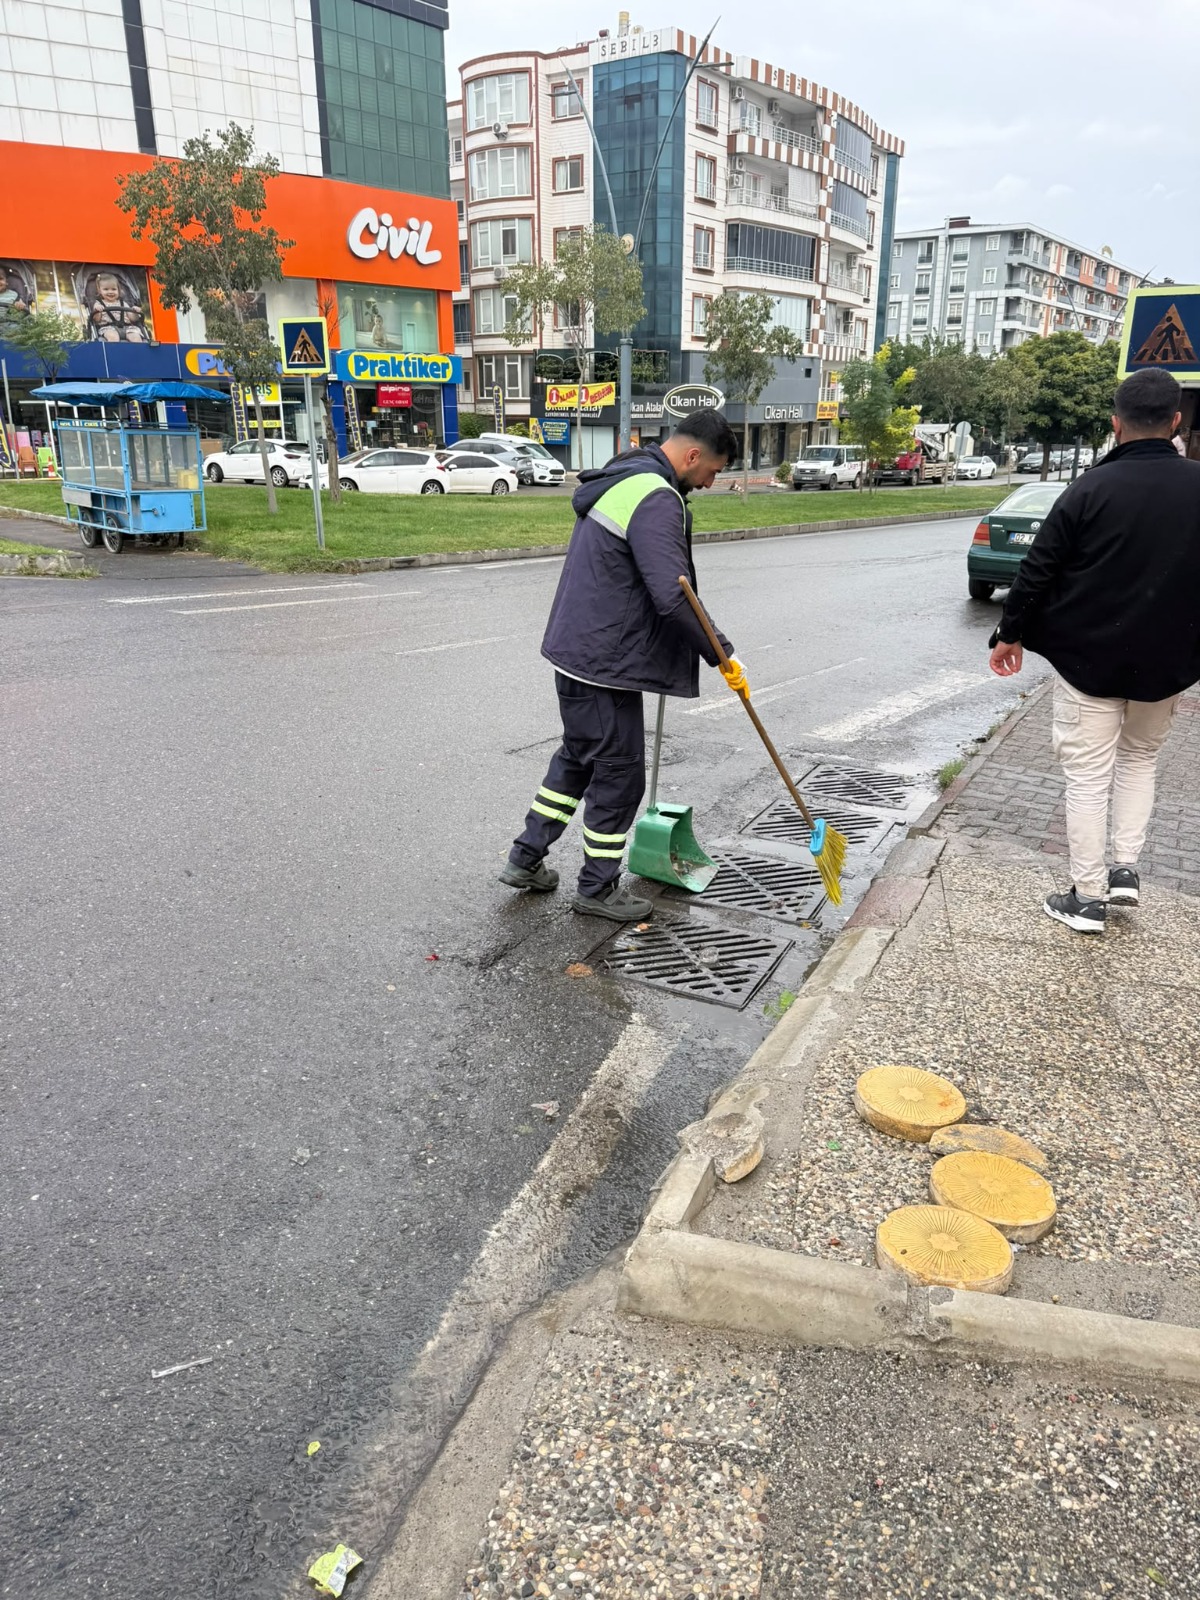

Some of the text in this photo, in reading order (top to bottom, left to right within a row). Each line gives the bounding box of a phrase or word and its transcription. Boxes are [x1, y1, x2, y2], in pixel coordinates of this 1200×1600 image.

[353, 355, 449, 379] Praktiker
[551, 390, 558, 403] 1
[670, 395, 717, 407] Okan Halı
[764, 405, 787, 420] Okan
[788, 405, 803, 419] Halı
[1015, 534, 1026, 542] 02
